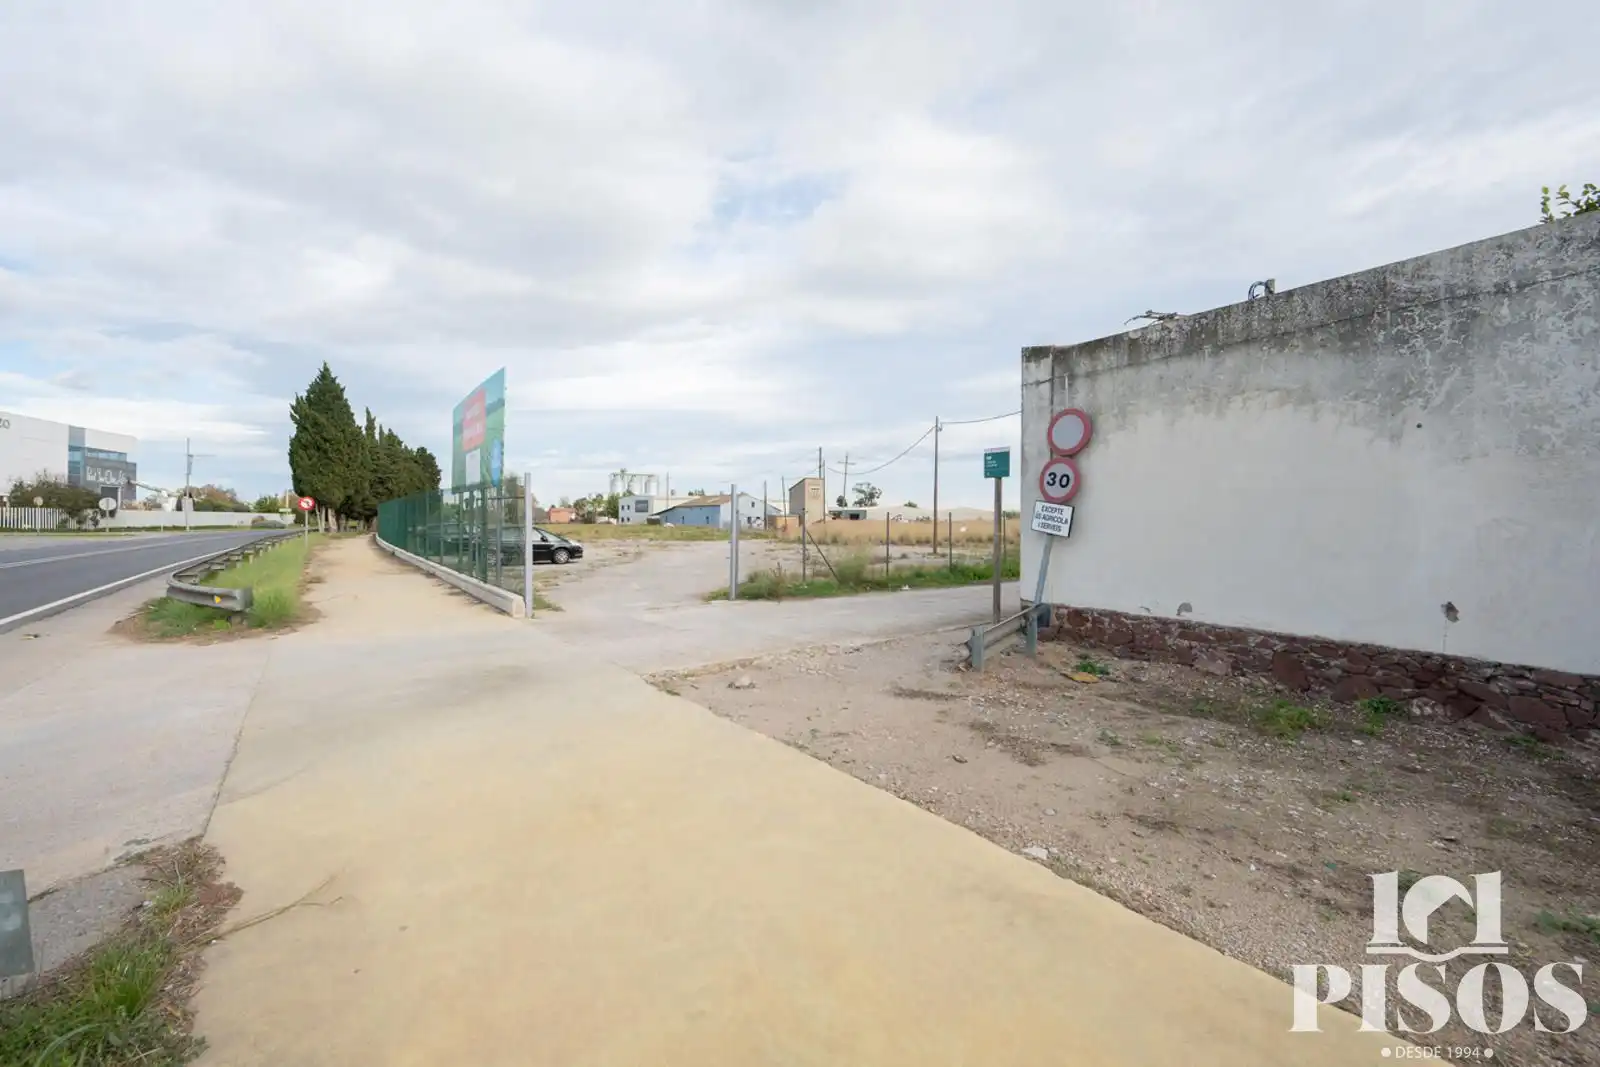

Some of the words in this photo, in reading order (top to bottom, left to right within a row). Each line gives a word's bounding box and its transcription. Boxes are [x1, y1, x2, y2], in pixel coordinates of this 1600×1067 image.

[1047, 472, 1070, 488] 30
[1041, 504, 1064, 515] EXCEPTE
[1041, 522, 1062, 532] SERVEIS
